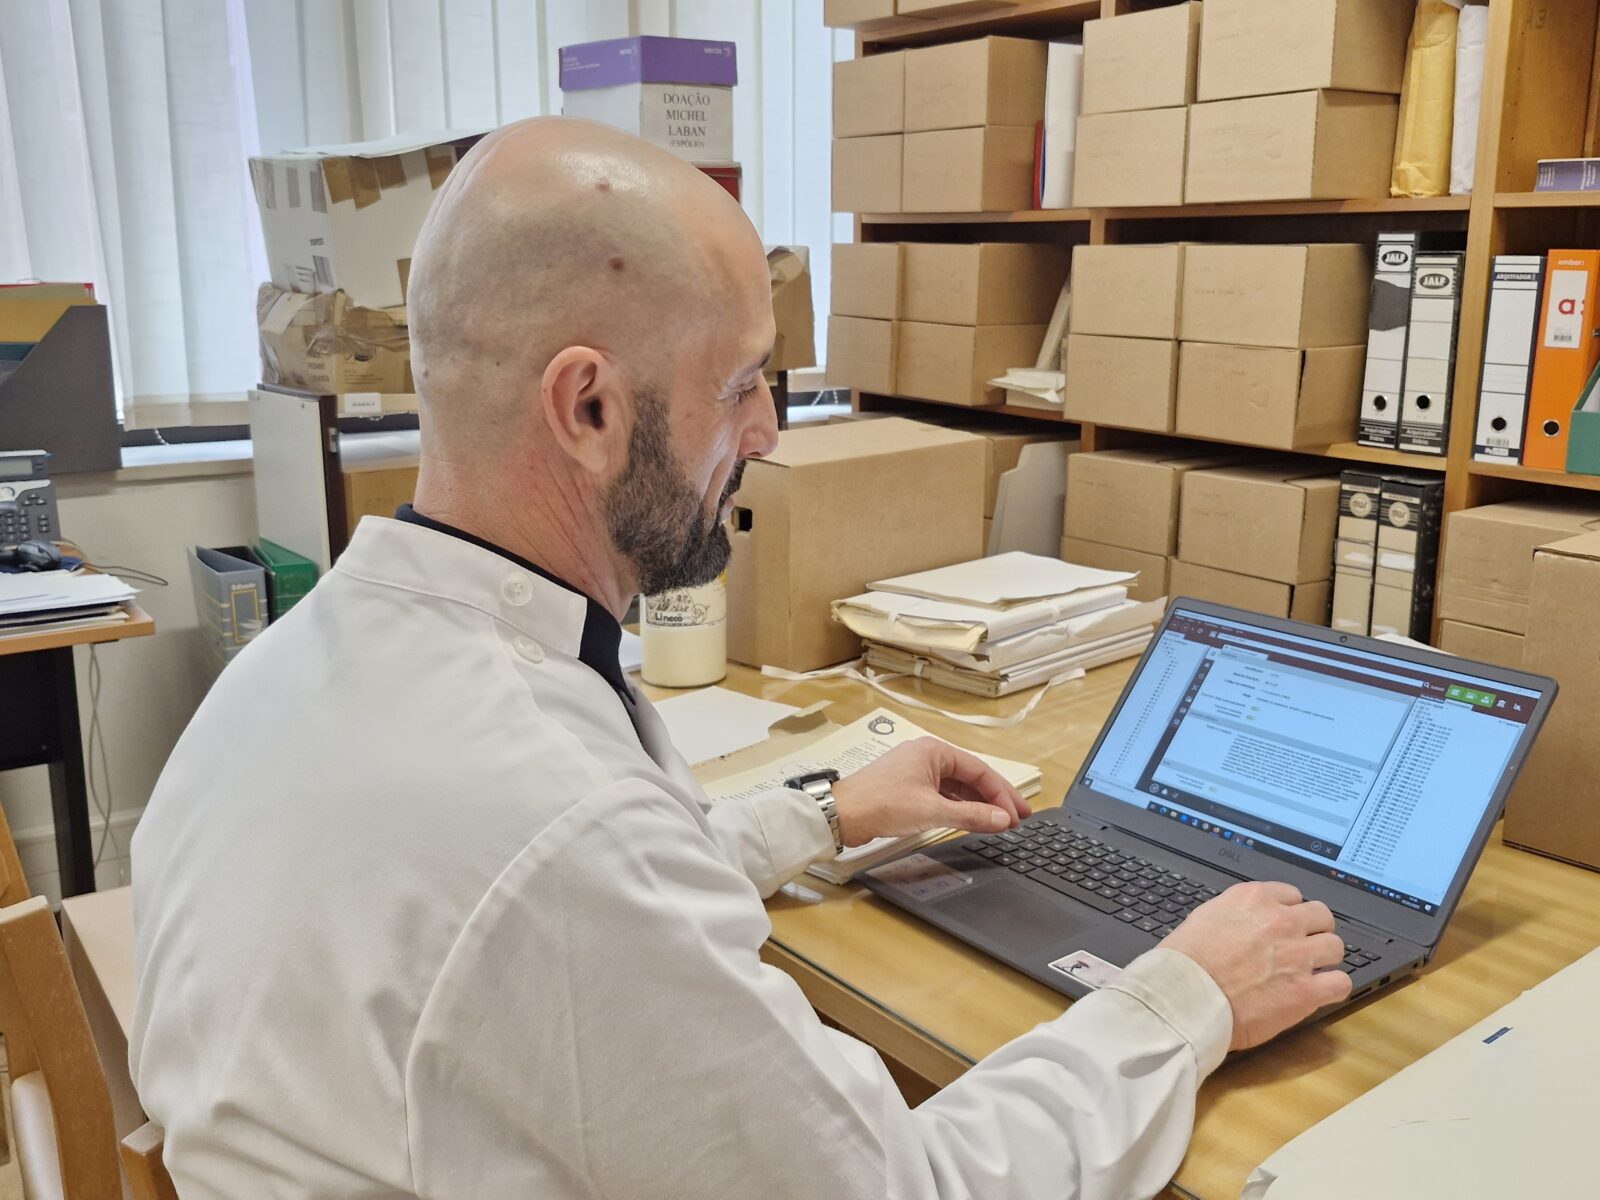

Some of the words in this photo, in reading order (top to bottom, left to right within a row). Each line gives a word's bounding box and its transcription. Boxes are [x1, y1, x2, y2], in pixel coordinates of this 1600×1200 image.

[663, 92, 711, 106] DOAÇÃO
[666, 109, 708, 122] MICHEL
[668, 125, 706, 137] LABAN
